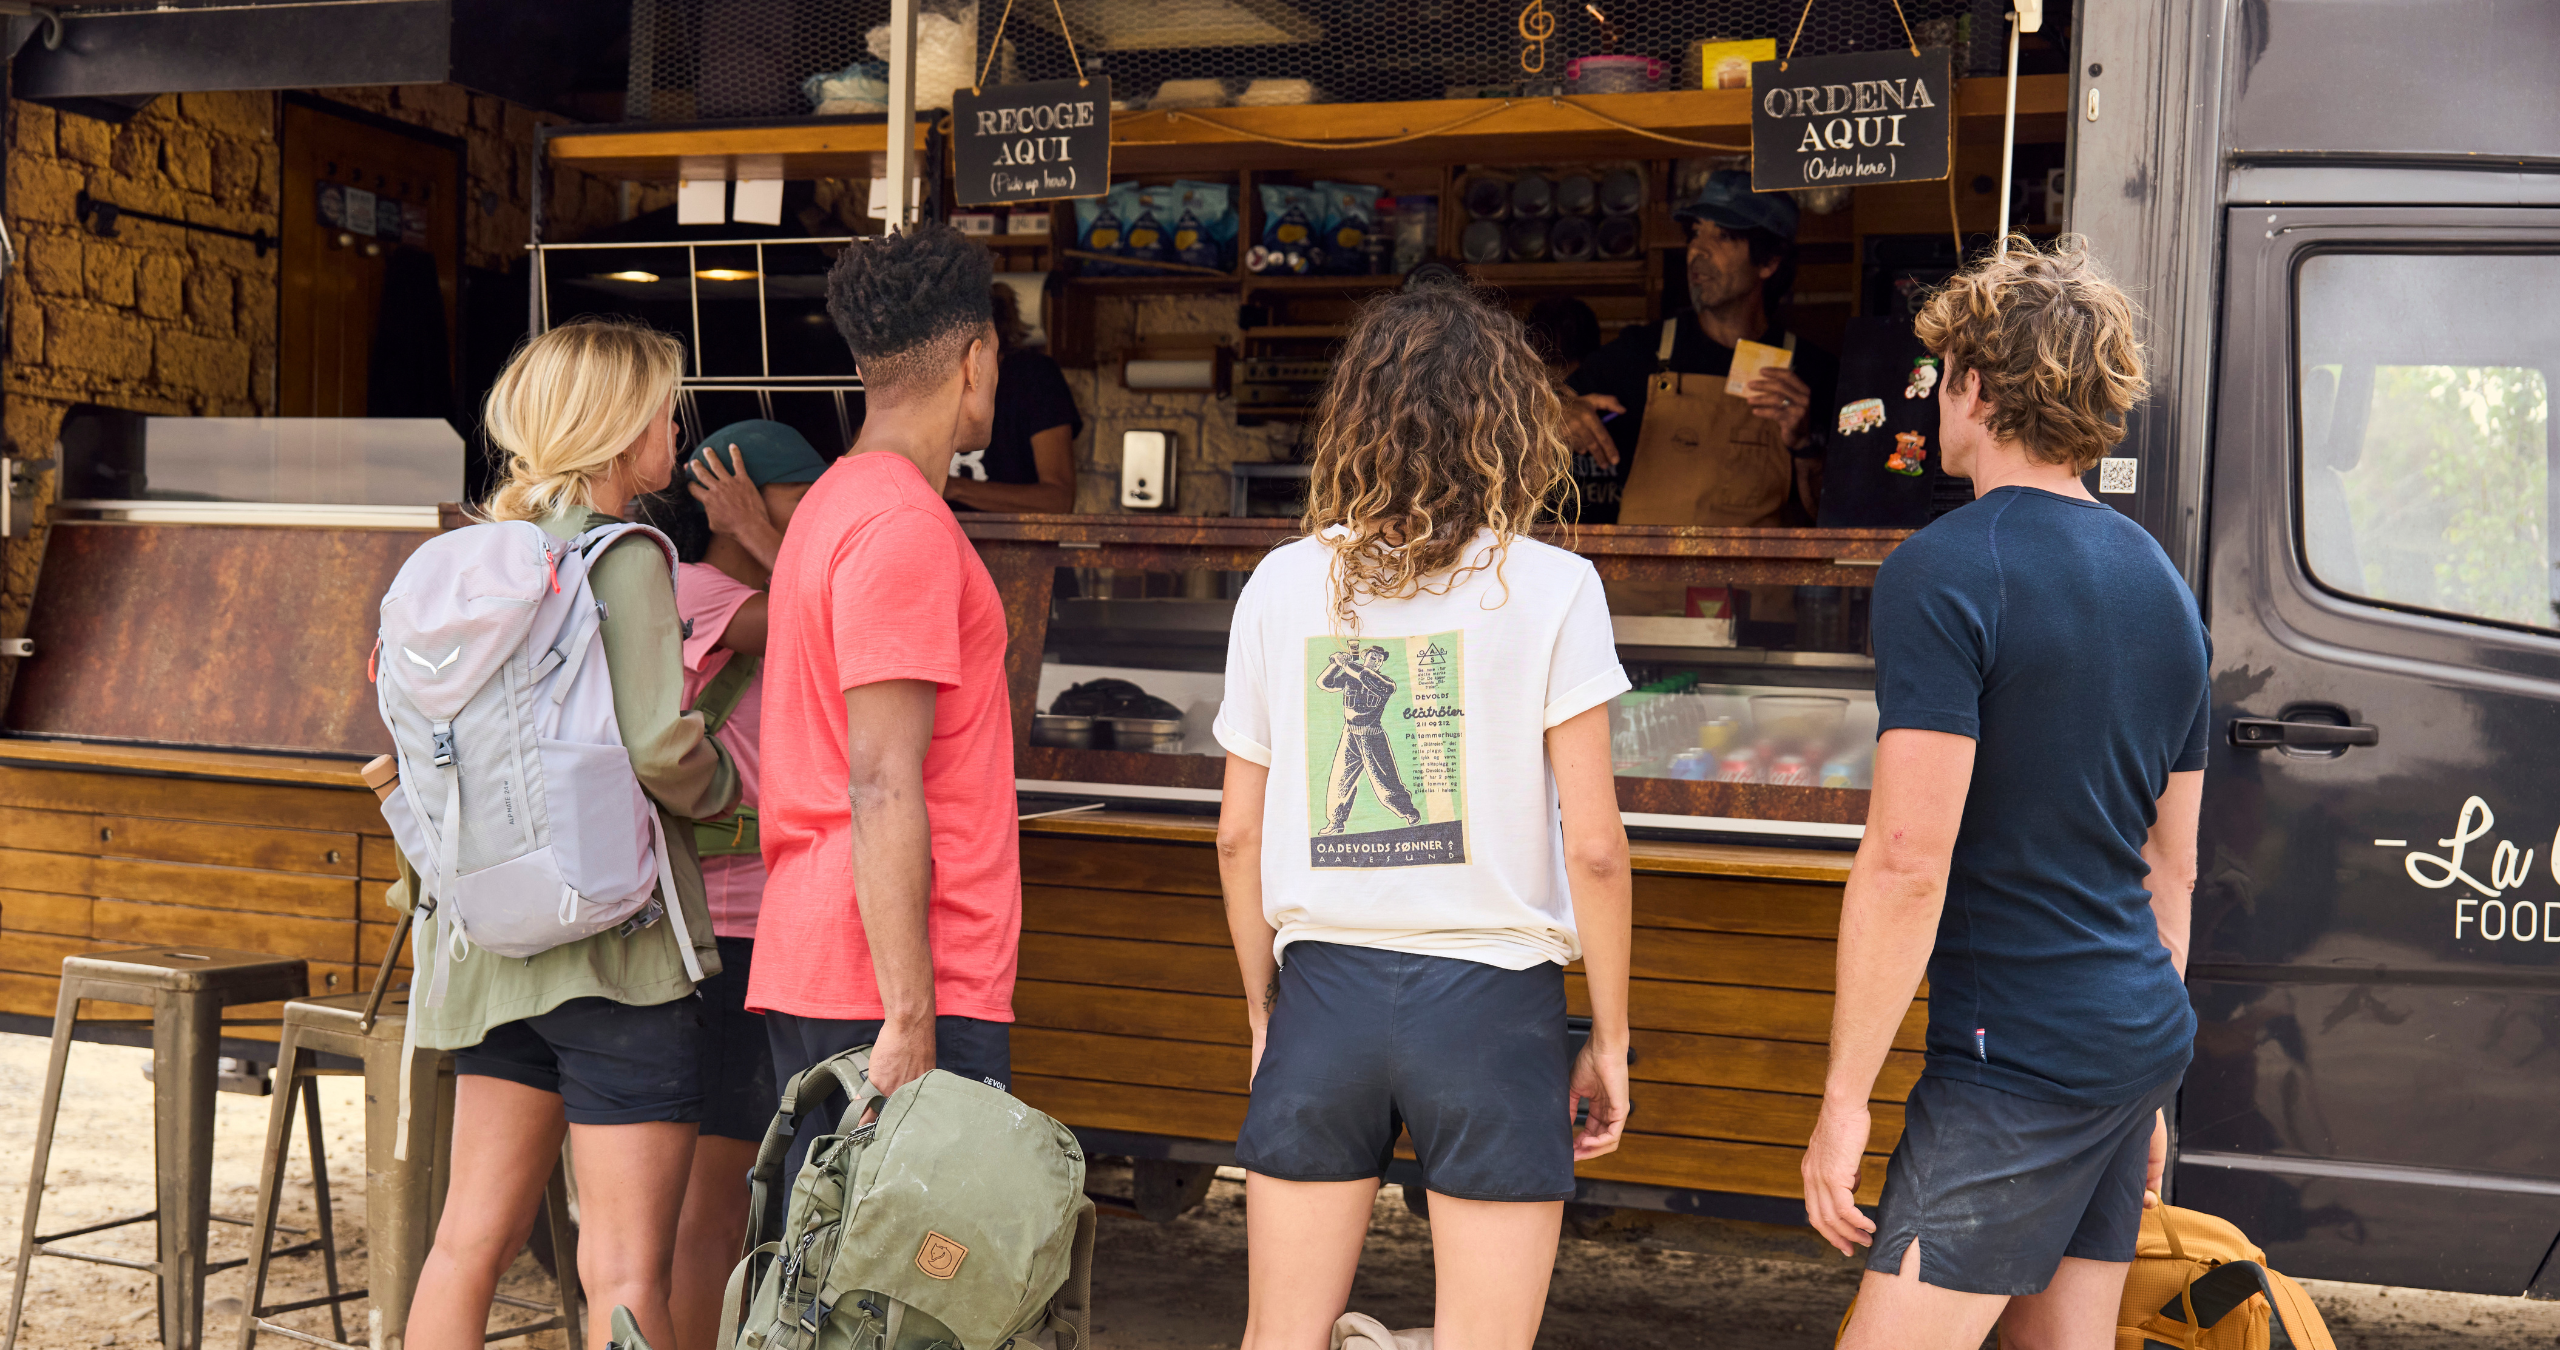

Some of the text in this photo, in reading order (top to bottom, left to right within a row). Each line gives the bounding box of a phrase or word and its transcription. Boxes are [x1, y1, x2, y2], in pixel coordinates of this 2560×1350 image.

[1764, 77, 1935, 118] ORDENA
[974, 101, 1094, 136] RECOGE
[1797, 114, 1907, 152] AQUI
[993, 136, 1072, 166] AQUI
[1394, 840, 1443, 852] SØNNER
[2405, 795, 2534, 897] La
[2455, 899, 2560, 943] FOOD
